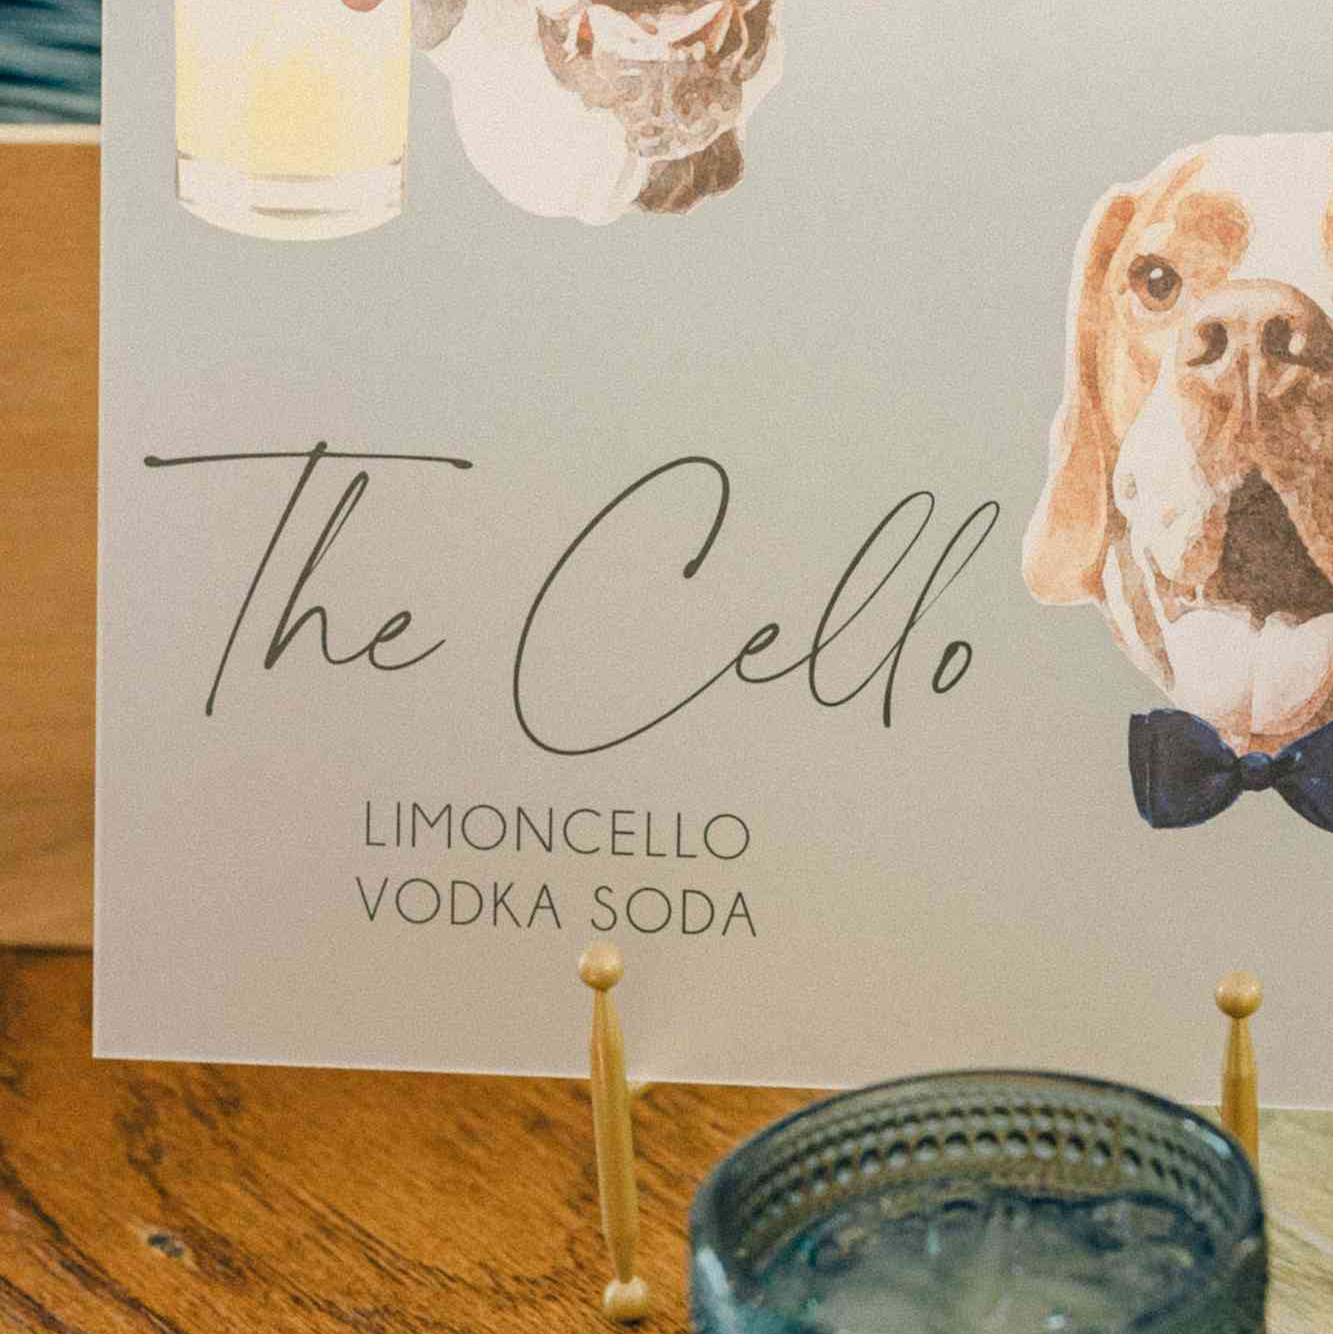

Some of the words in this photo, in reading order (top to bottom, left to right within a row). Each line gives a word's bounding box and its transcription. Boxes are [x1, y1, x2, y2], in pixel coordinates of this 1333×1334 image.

[142, 439, 475, 719] The
[511, 454, 1002, 758] Cello
[364, 799, 752, 862] LIMONCELLO
[354, 875, 563, 931] VODKA
[590, 884, 758, 939] SODA
